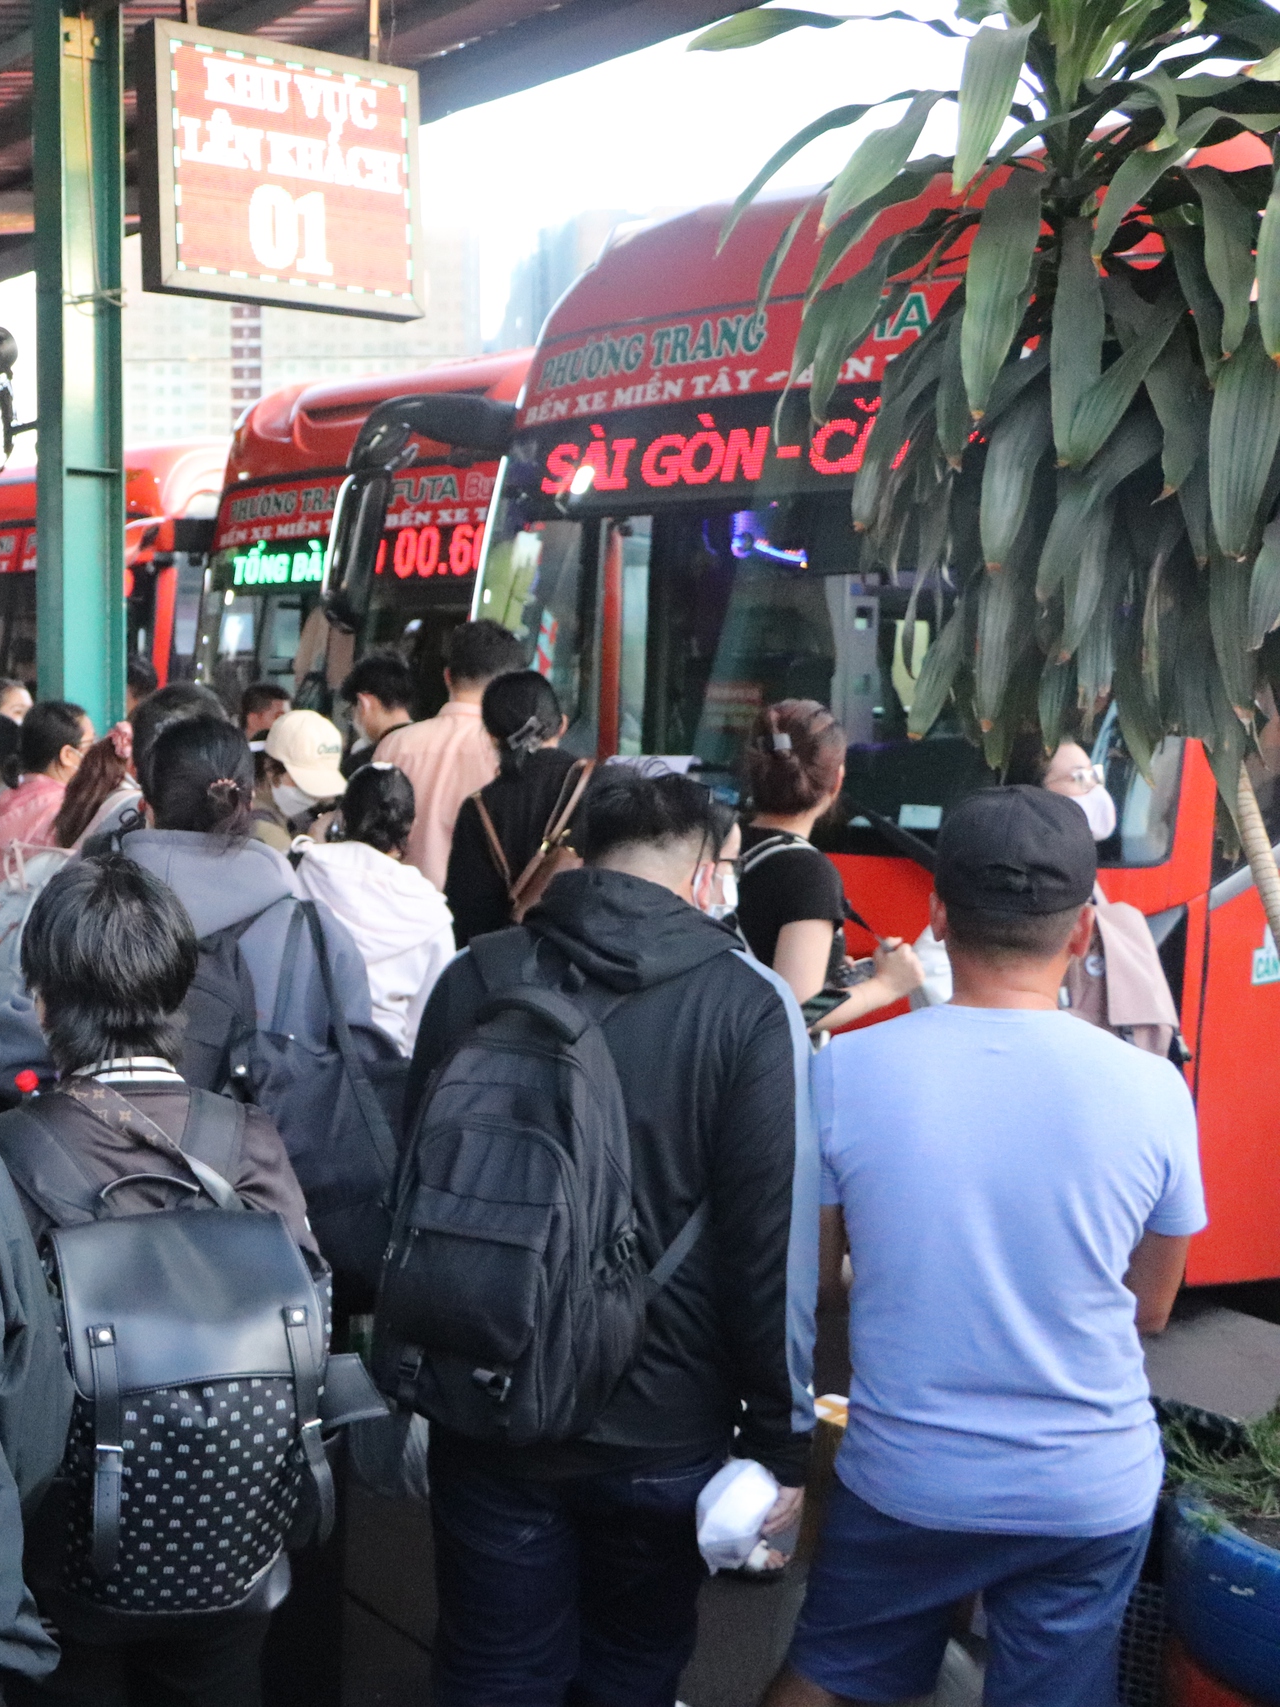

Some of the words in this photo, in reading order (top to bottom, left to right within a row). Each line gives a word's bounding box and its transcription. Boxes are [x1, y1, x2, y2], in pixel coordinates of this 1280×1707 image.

[203, 57, 291, 114] KHU
[181, 108, 264, 172] LÊN
[249, 184, 334, 276] 01
[538, 332, 645, 394] PHƯƠNG
[650, 311, 768, 369] TRANG
[573, 390, 608, 415] XE
[691, 366, 759, 397] TÂY
[541, 423, 637, 495] SÀI
[640, 412, 771, 487] GÒN
[391, 474, 458, 506] FUTA
[436, 506, 475, 523] XE
[291, 539, 328, 582] ĐÀ
